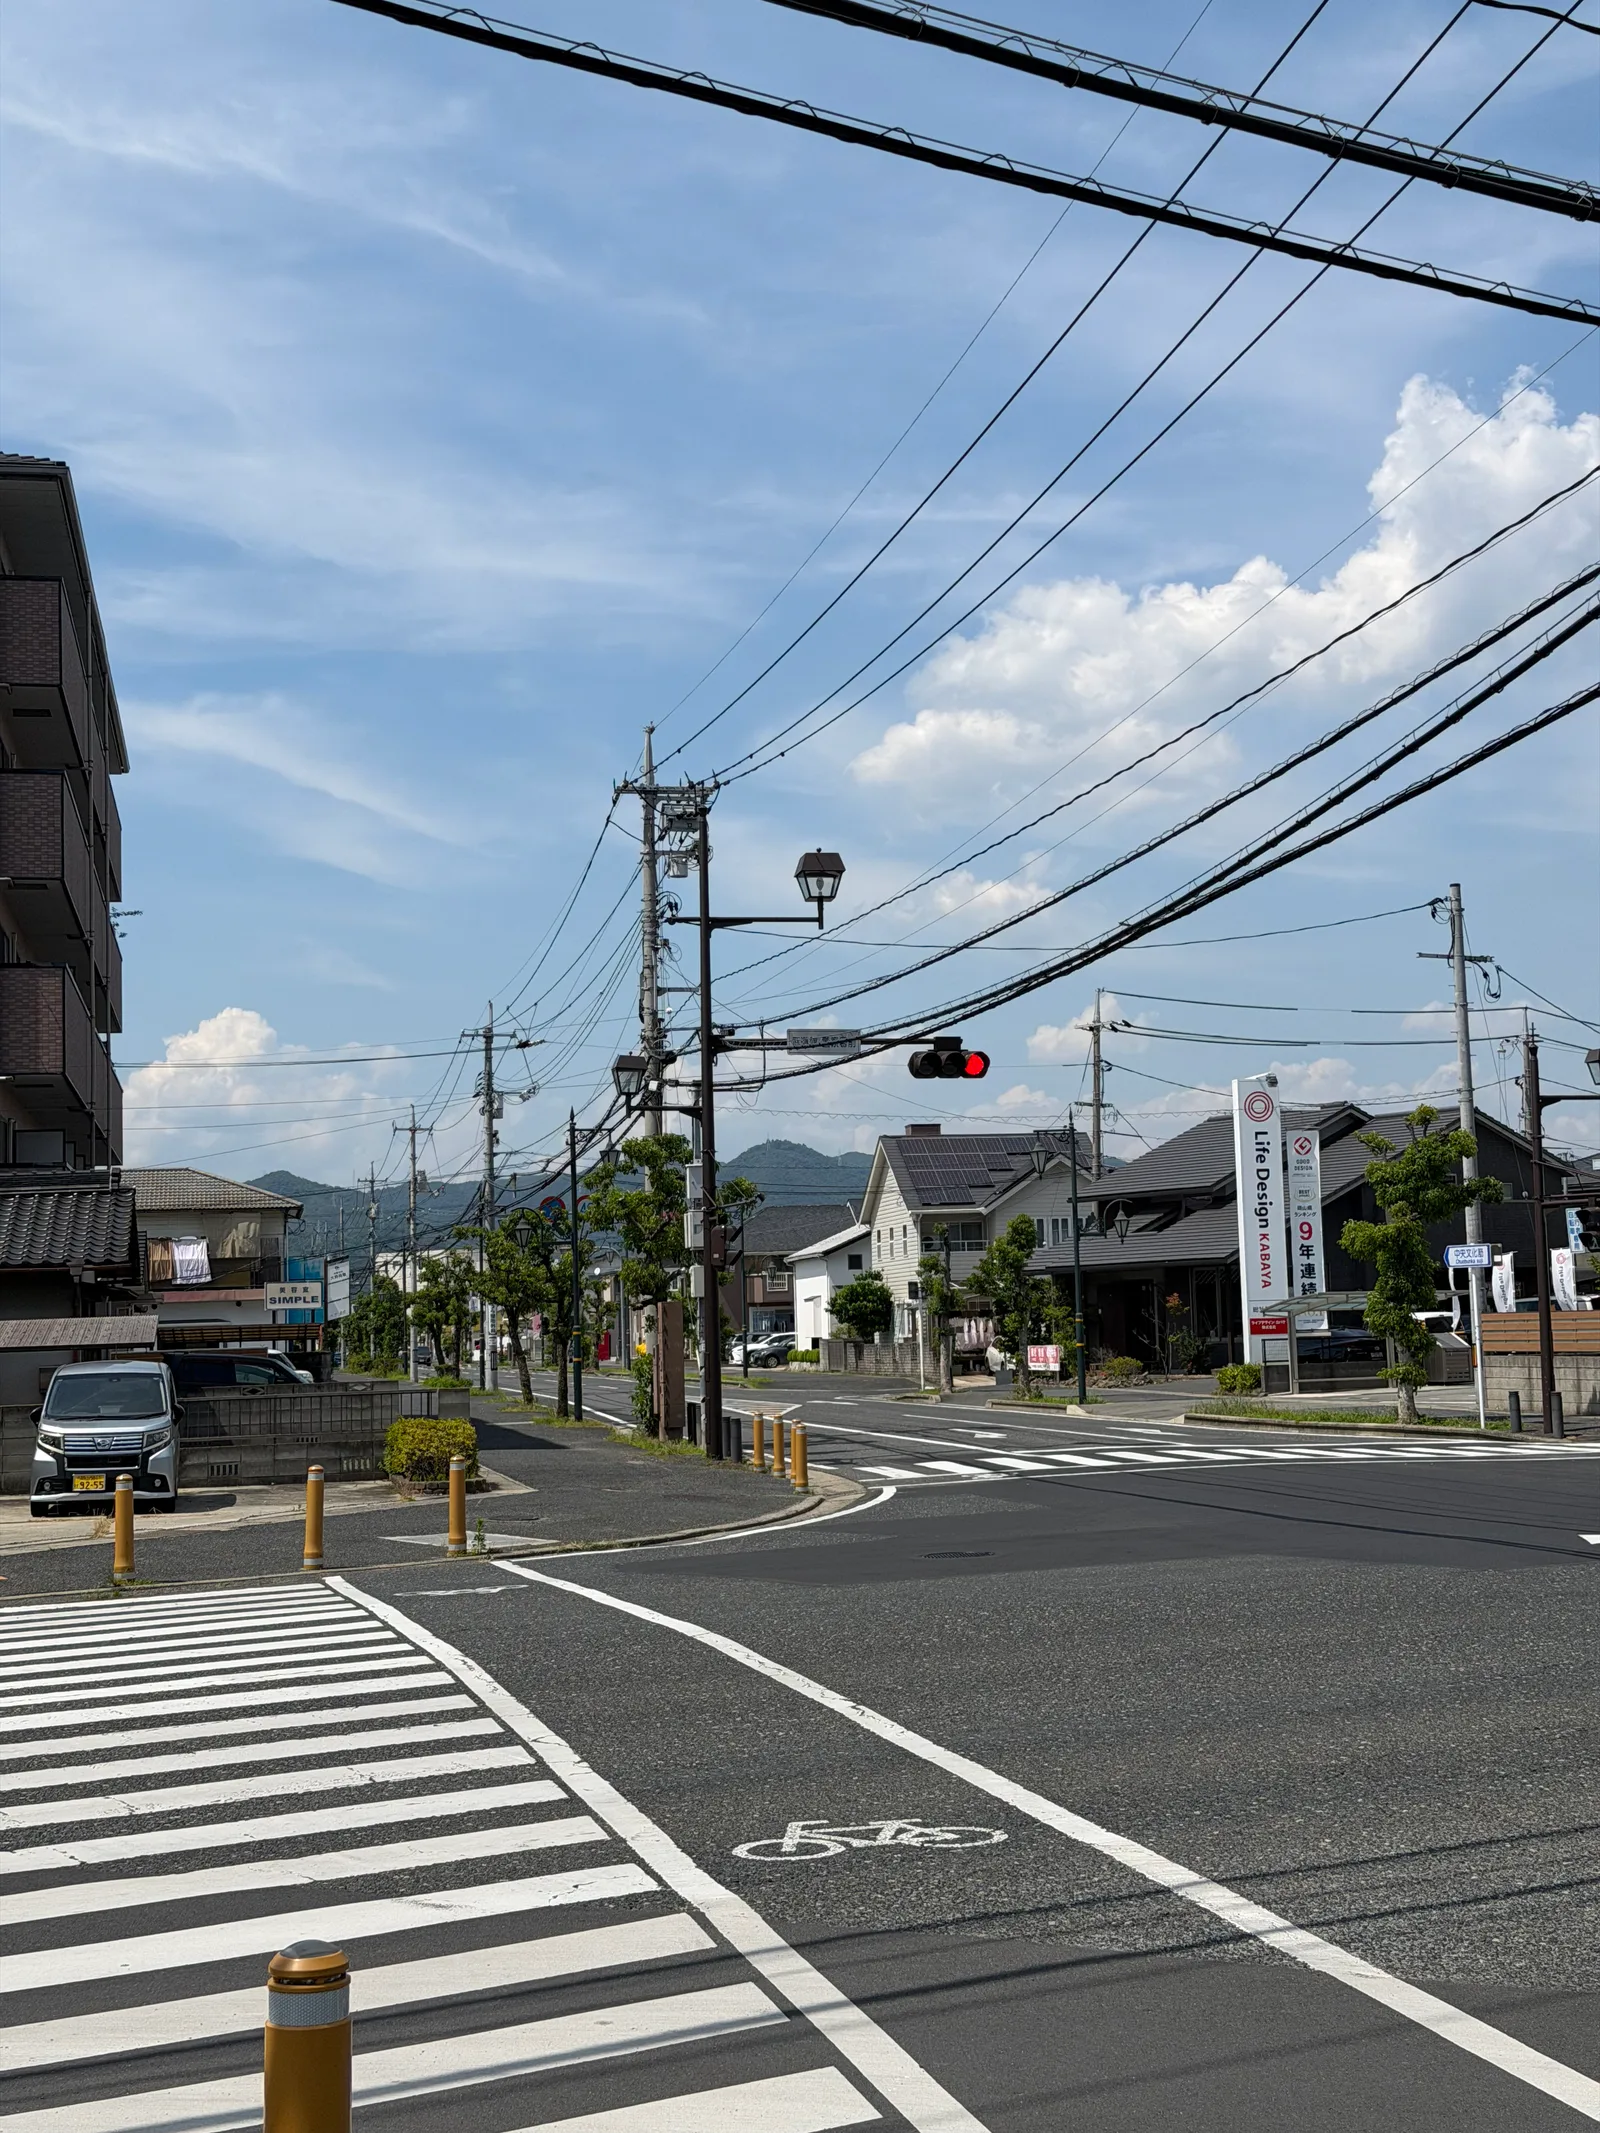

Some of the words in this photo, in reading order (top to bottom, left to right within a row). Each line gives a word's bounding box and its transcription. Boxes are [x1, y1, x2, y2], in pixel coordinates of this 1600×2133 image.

[1254, 1131, 1271, 1164] Life
[1254, 1168, 1273, 1229] Design
[1259, 1233, 1272, 1289] KABAYA
[269, 1296, 319, 1304] SIMPLE
[279, 1286, 310, 1294] 美容室
[79, 1481, 104, 1489] 92-55
